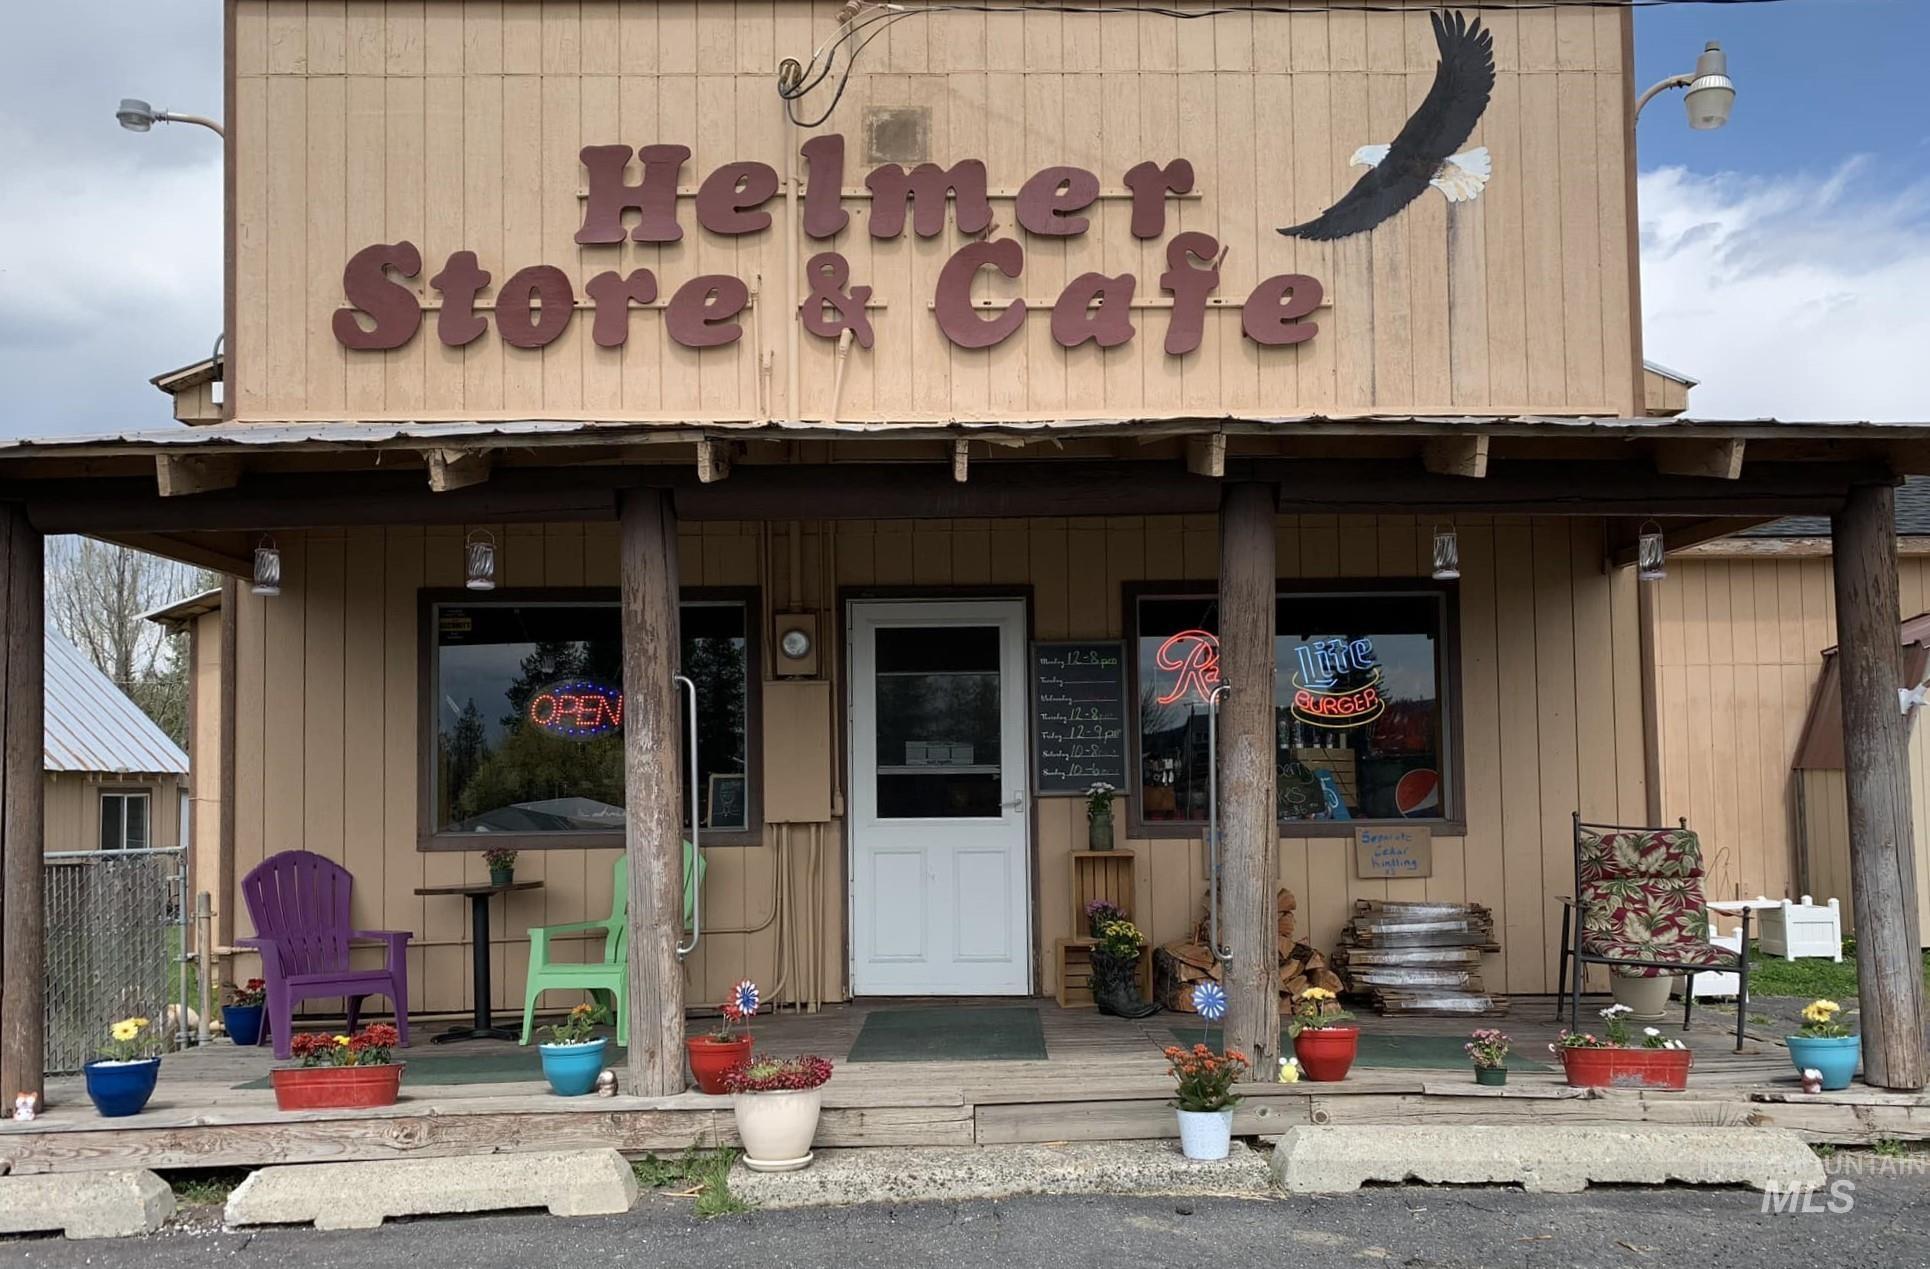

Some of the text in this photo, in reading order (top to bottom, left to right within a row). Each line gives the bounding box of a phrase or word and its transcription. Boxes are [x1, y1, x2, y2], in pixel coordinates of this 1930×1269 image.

[574, 134, 1195, 245] Helmer
[332, 231, 1325, 356] Store & Cafe
[1294, 638, 1373, 688] Lite
[531, 693, 623, 726] OPEN
[1294, 688, 1379, 715] BURGER
